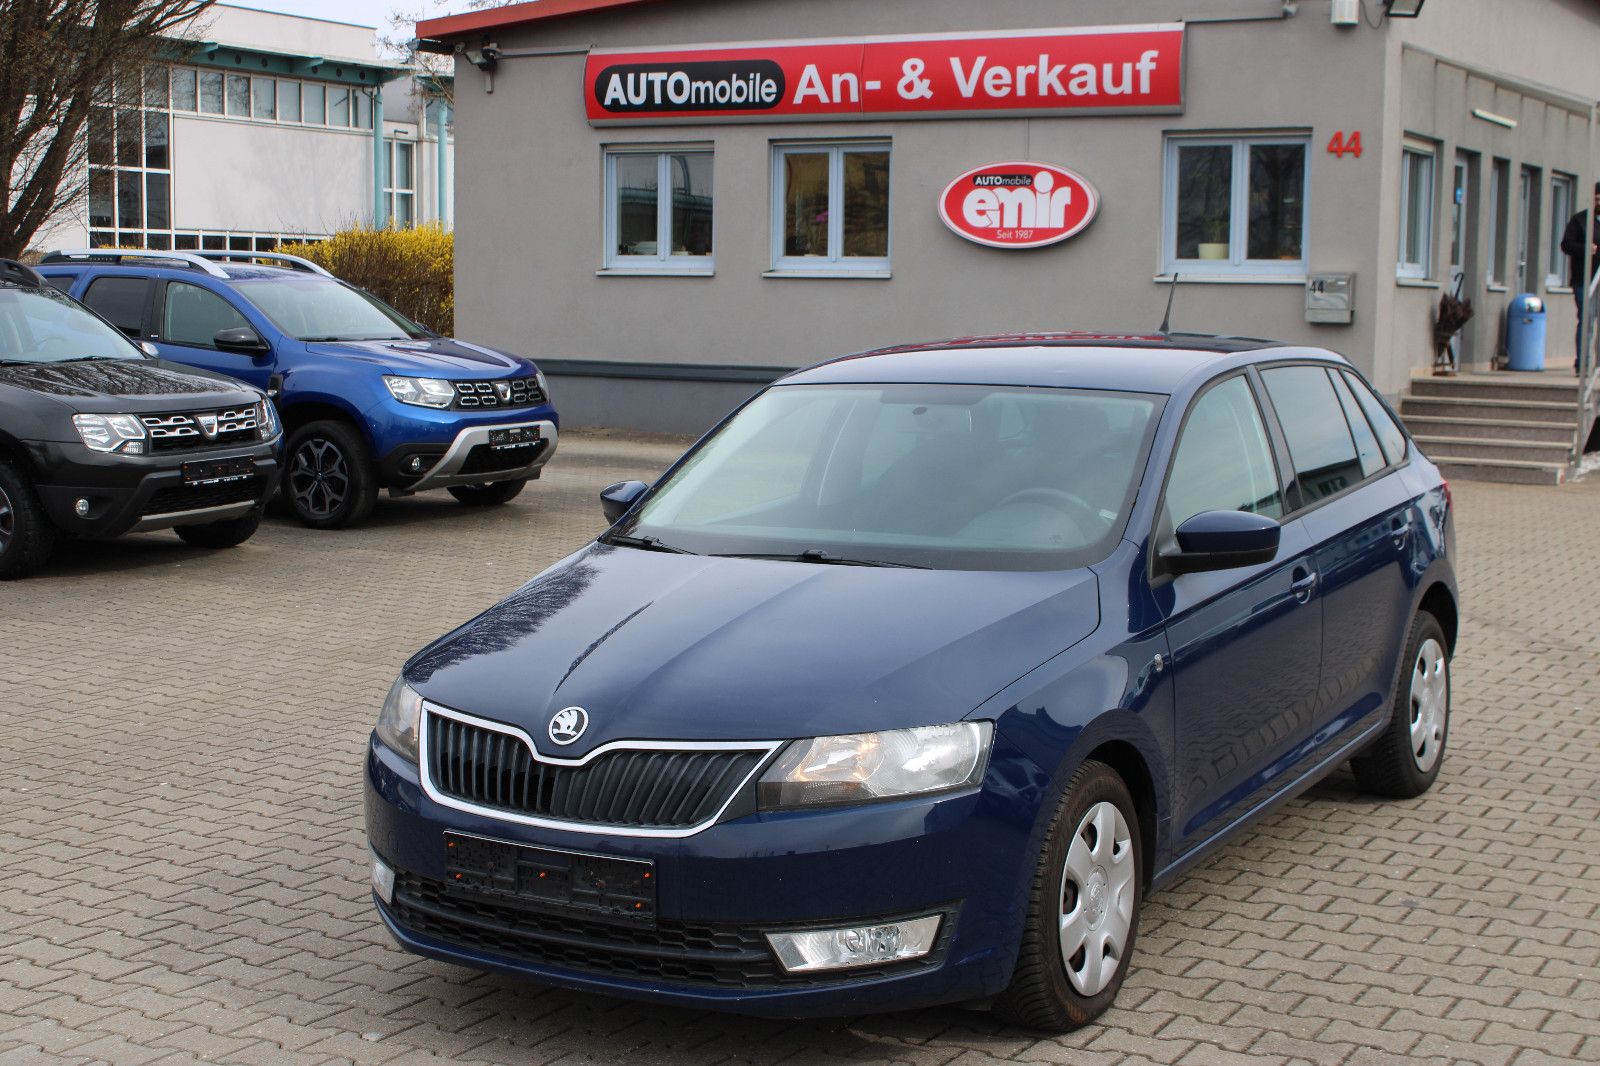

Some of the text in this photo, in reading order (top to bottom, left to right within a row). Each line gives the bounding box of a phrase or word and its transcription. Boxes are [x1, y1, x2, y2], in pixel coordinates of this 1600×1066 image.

[604, 50, 1160, 105] AUTOmobile An- & Verkauf
[1327, 130, 1362, 158] 44
[975, 175, 1032, 187] AUTOmobile
[962, 171, 1071, 229] emir
[996, 229, 1034, 240] Seit 1987
